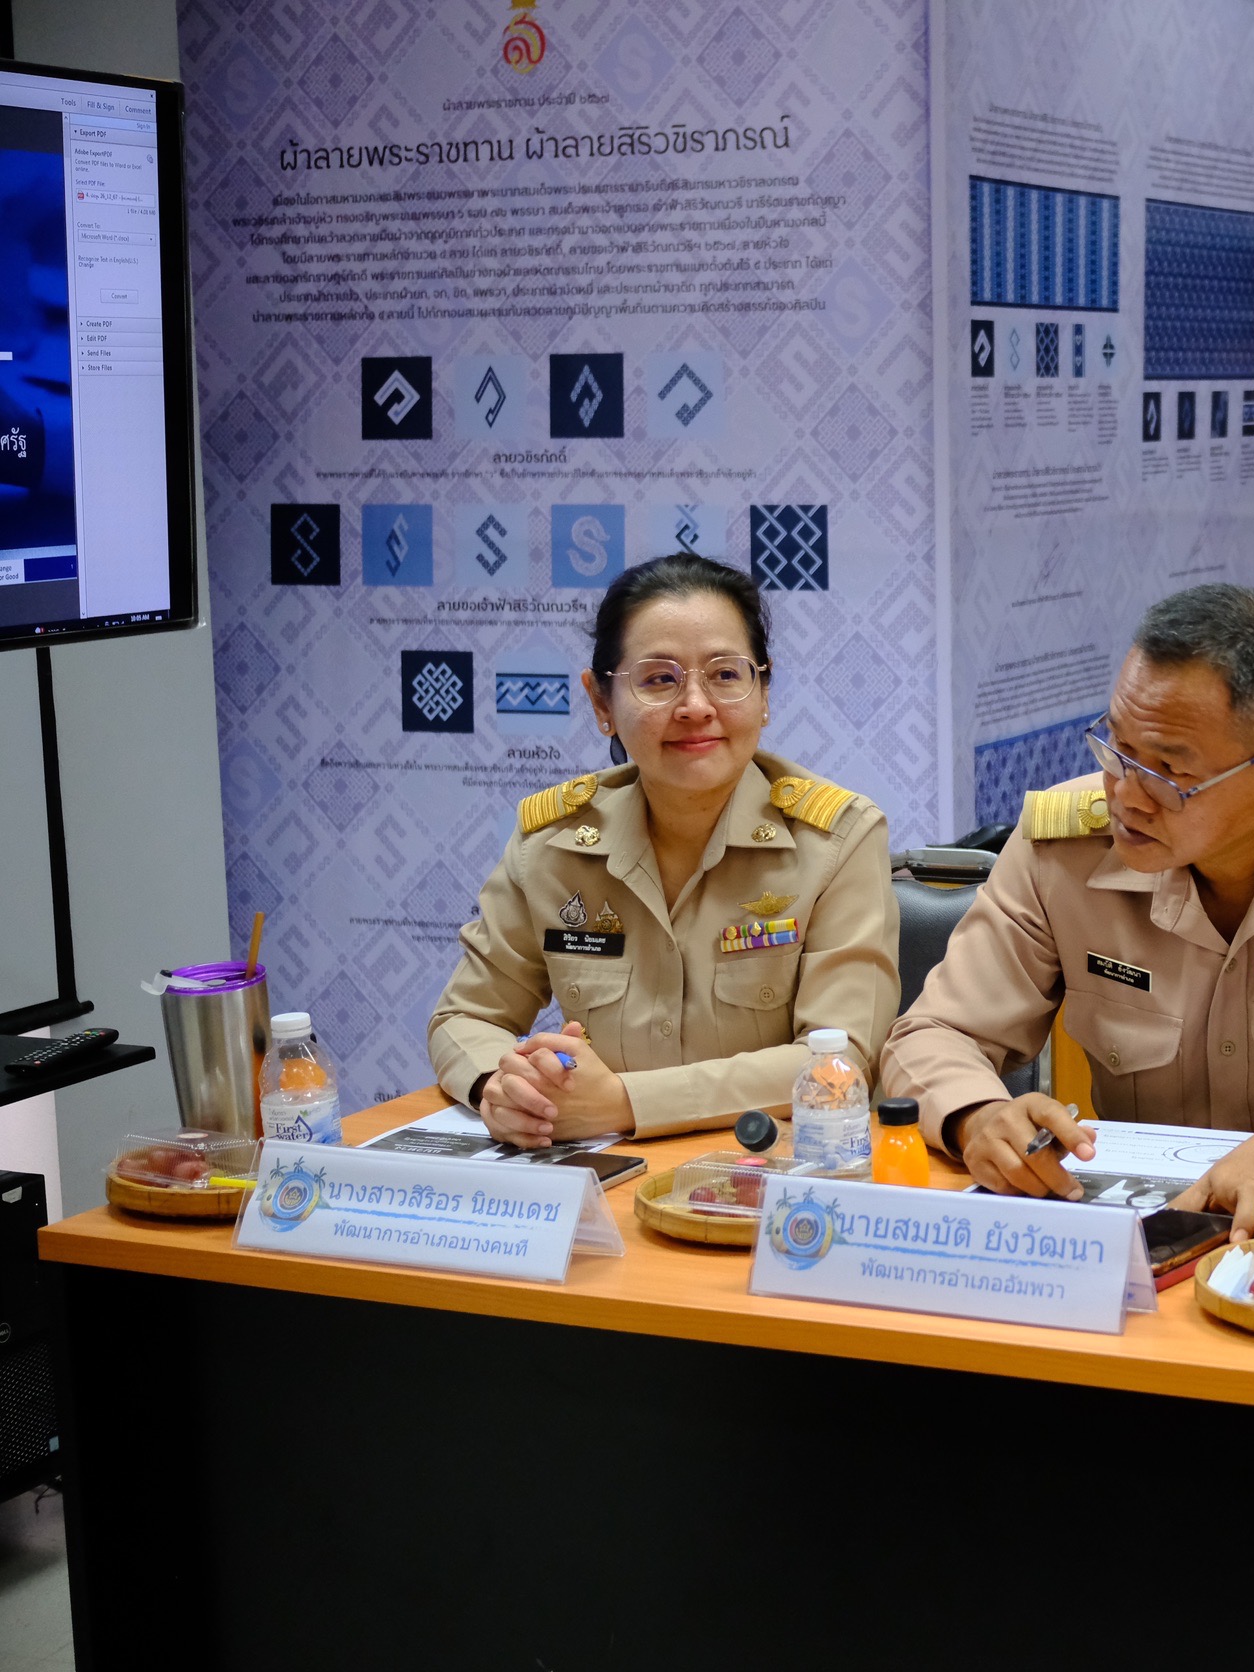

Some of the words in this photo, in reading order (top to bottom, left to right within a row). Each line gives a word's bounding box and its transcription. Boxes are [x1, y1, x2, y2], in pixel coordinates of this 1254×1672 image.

[61, 97, 77, 107] Tools
[87, 101, 96, 109] Fill
[103, 102, 115, 112] Sign
[124, 105, 152, 115] Comment
[79, 128, 94, 139] Export
[95, 130, 107, 138] PDF
[279, 139, 514, 172] ผ้าลายพระราชทาน
[525, 115, 791, 161] ผ้าลายสิริวชิราภรณ์
[86, 320, 102, 328] Create
[103, 320, 113, 328] PDF
[275, 1122, 302, 1134] First
[328, 1179, 464, 1213] นางสาวสิริอร
[472, 1191, 562, 1223] นิยมเดช
[838, 1212, 972, 1249] นายสมบัติ
[984, 1220, 1105, 1264] ยังวัฒนา
[860, 1256, 1066, 1300] พัฒนาการอำเภออัมพวา
